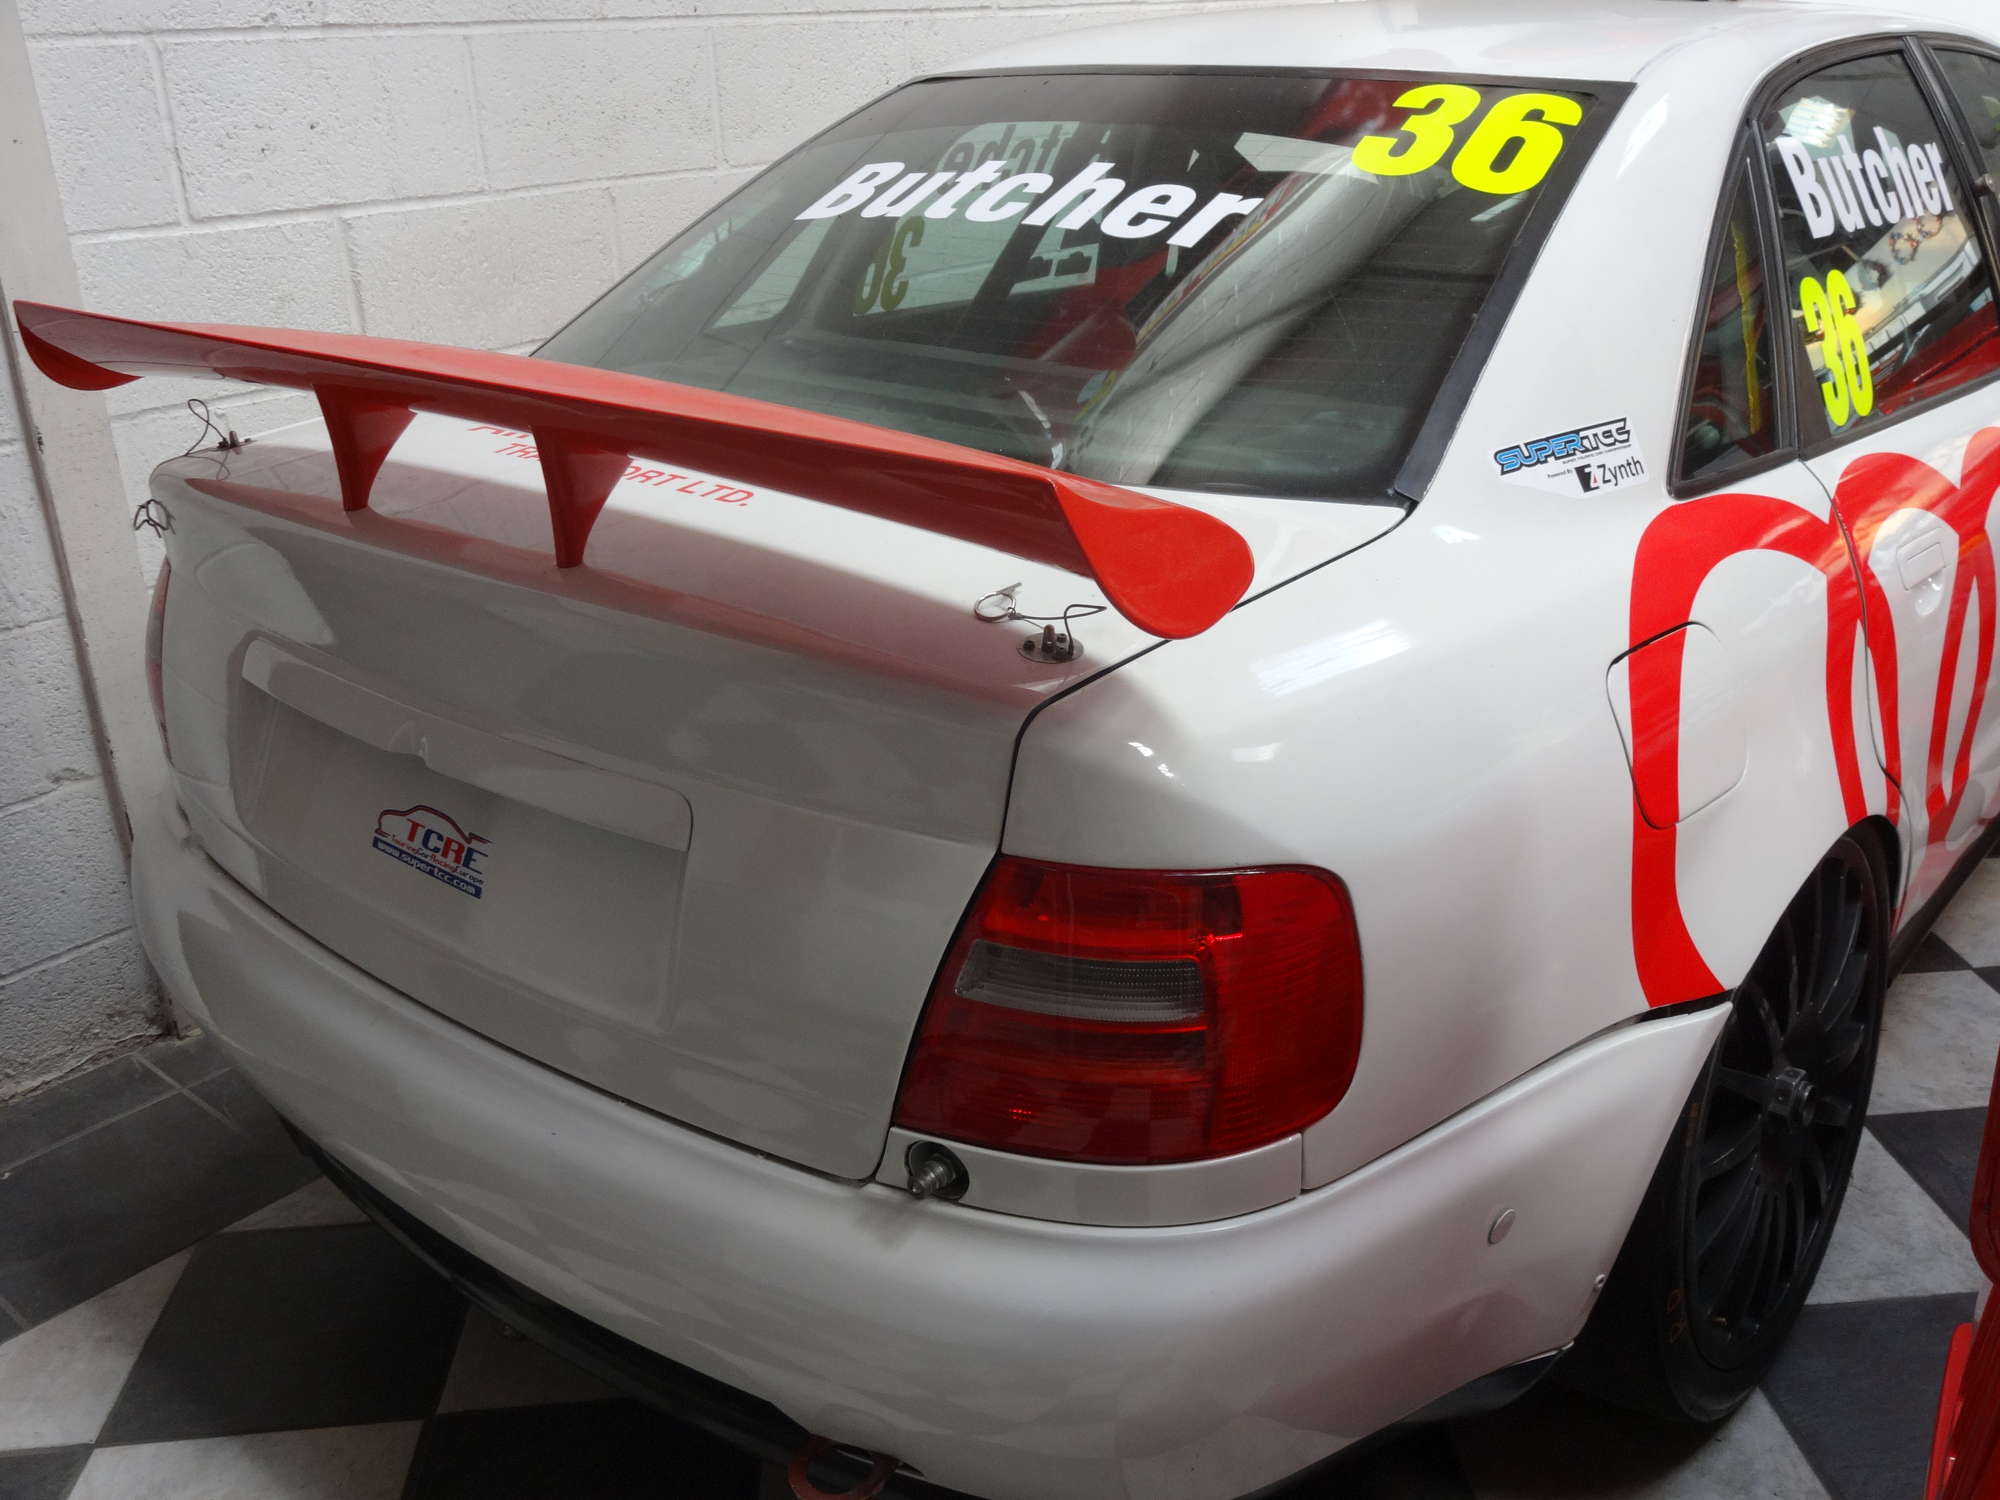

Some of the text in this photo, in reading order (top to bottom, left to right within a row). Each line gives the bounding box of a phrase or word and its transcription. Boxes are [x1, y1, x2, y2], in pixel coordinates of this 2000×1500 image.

[1352, 84, 1583, 194] 36
[1776, 126, 1953, 239] Butcher
[795, 160, 1264, 249] Butcher
[1800, 269, 1874, 427] 36
[1597, 456, 1645, 486] Zynth
[406, 818, 488, 875] TCRE
